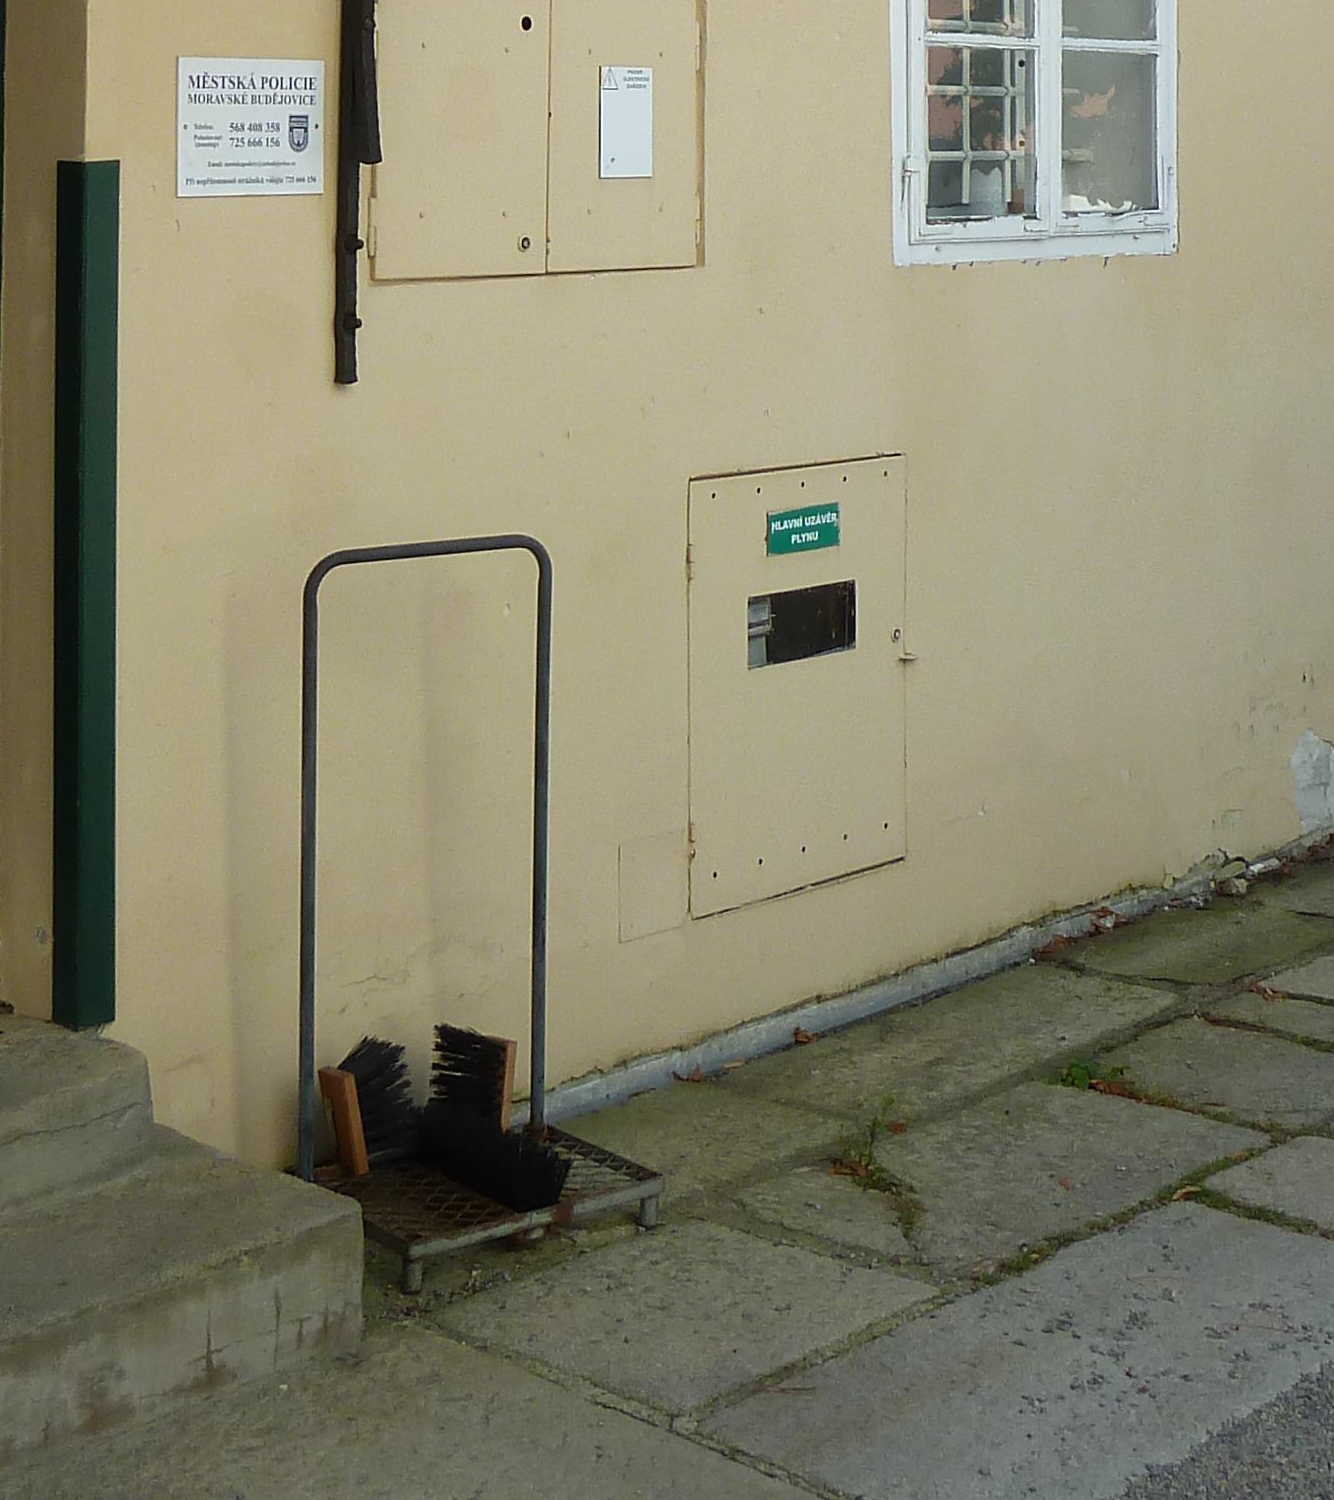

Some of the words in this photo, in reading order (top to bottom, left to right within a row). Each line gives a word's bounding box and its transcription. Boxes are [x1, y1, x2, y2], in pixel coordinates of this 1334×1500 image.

[188, 71, 257, 90] MĚSTSKÁ
[260, 76, 317, 91] POLICIE
[187, 92, 249, 105] MORAVSKÉ
[250, 93, 317, 106] BUDĚJOVICE
[229, 137, 245, 148] 725
[247, 137, 263, 148] 666
[265, 137, 281, 148] 156
[771, 516, 803, 532] HLAVNÍ
[791, 531, 819, 544] PLYNU
